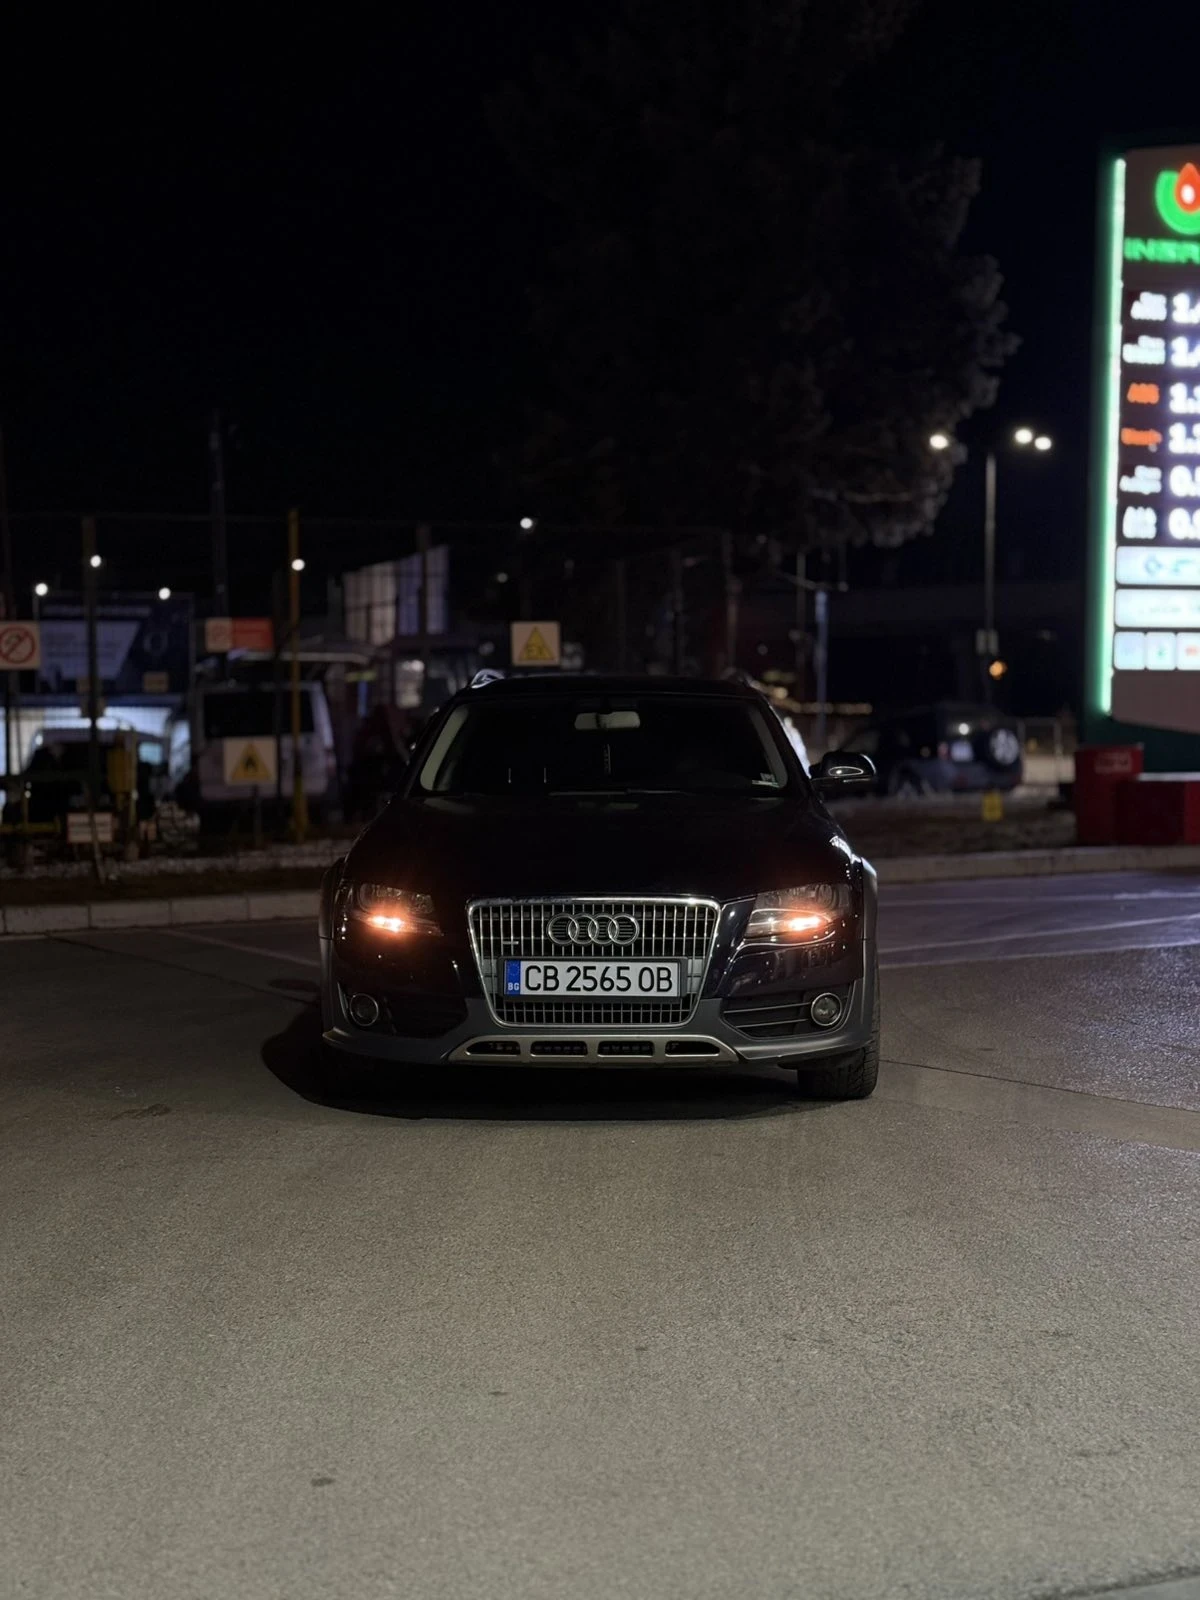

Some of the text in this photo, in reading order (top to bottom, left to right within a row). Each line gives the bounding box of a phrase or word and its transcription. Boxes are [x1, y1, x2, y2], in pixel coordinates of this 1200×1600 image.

[508, 982, 520, 991] BG
[525, 965, 560, 991] CB
[566, 965, 632, 992] 2565
